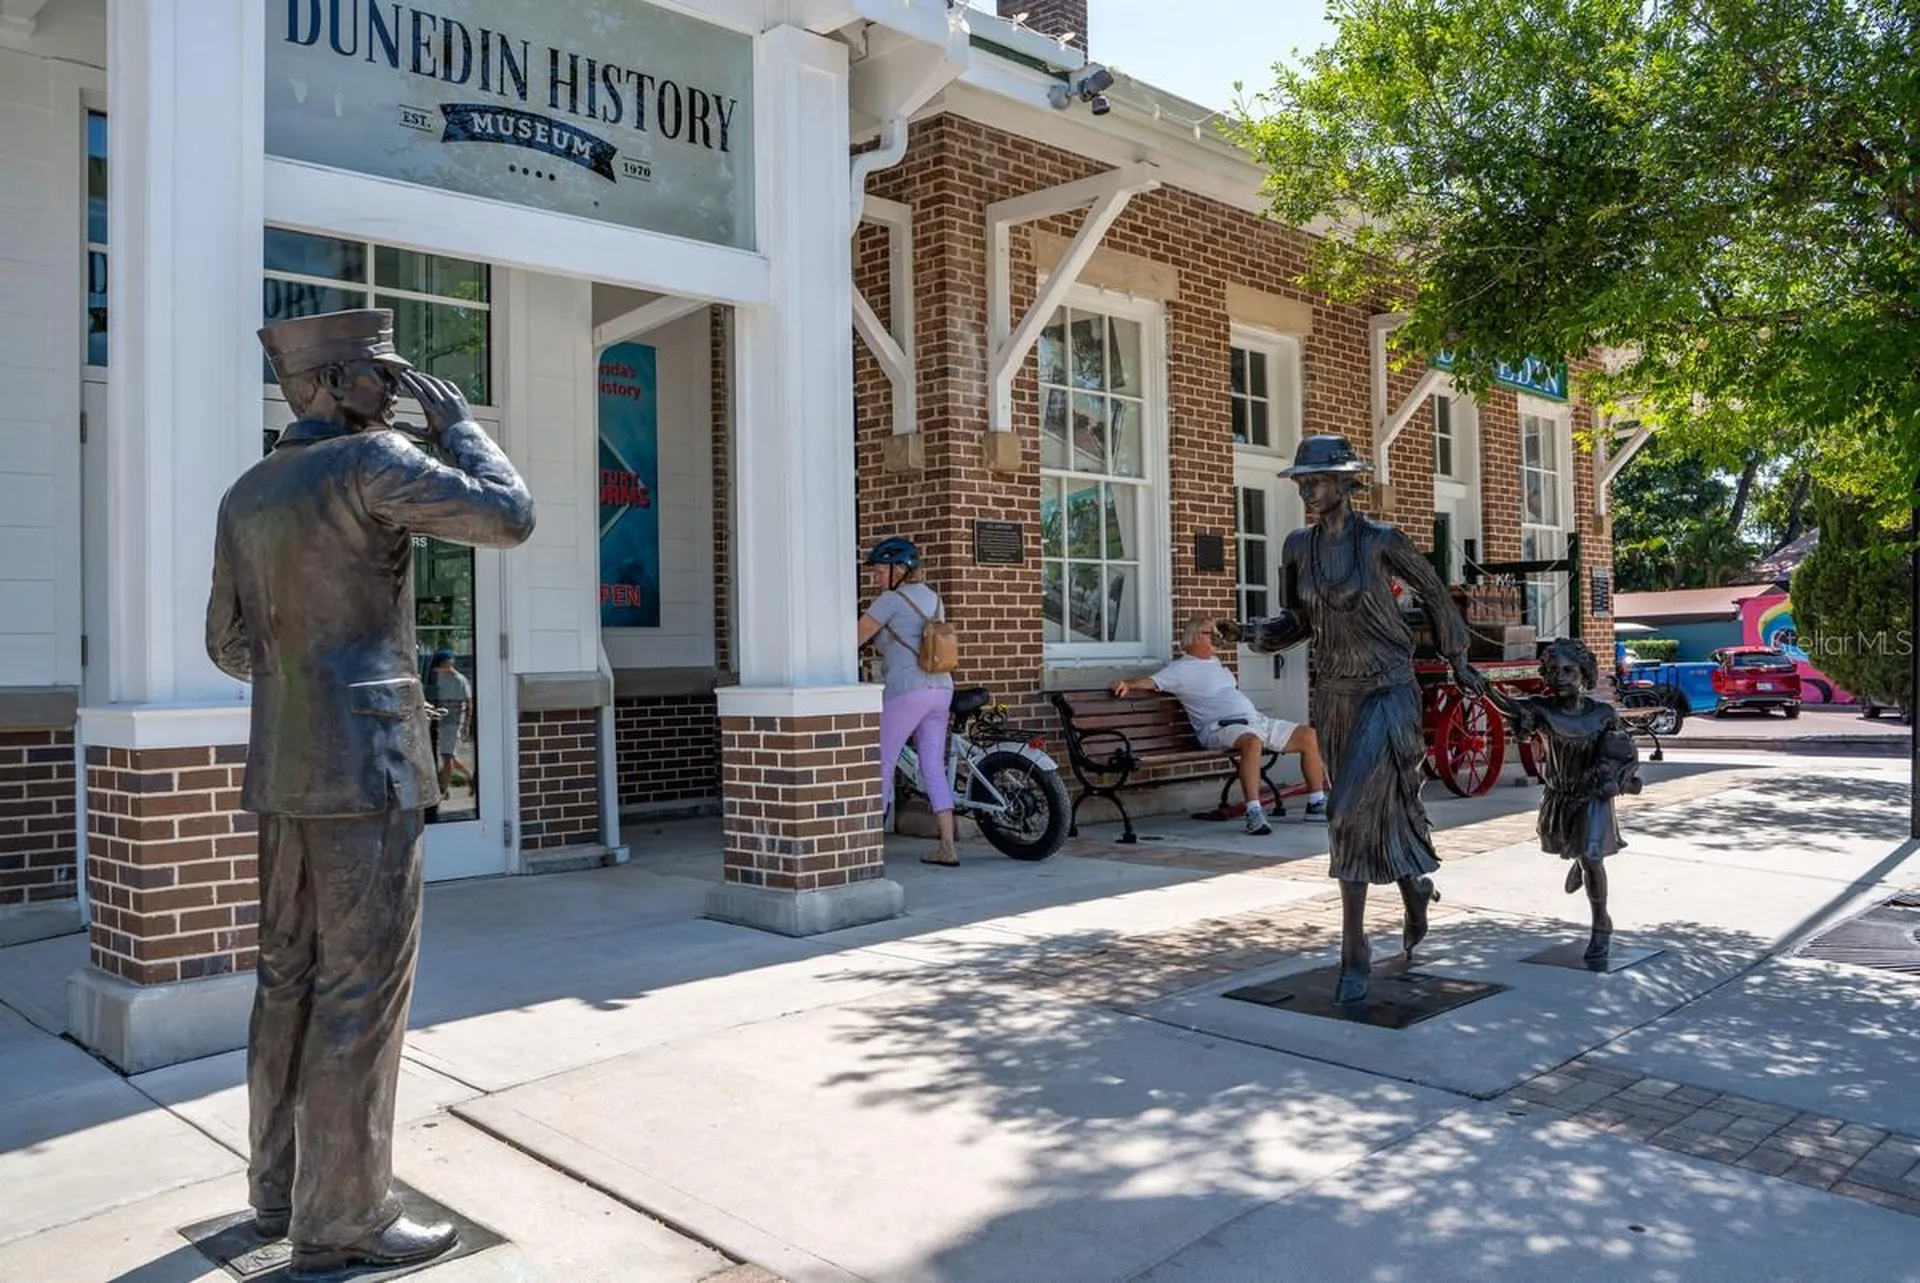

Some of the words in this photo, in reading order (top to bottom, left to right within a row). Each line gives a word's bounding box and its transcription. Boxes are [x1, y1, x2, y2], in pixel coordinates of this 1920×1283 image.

[285, 0, 531, 102] DUNEDIN
[547, 46, 738, 153] HISTORY
[402, 111, 432, 129] EST.
[470, 112, 596, 160] MUSEUM
[622, 161, 652, 178] 1970
